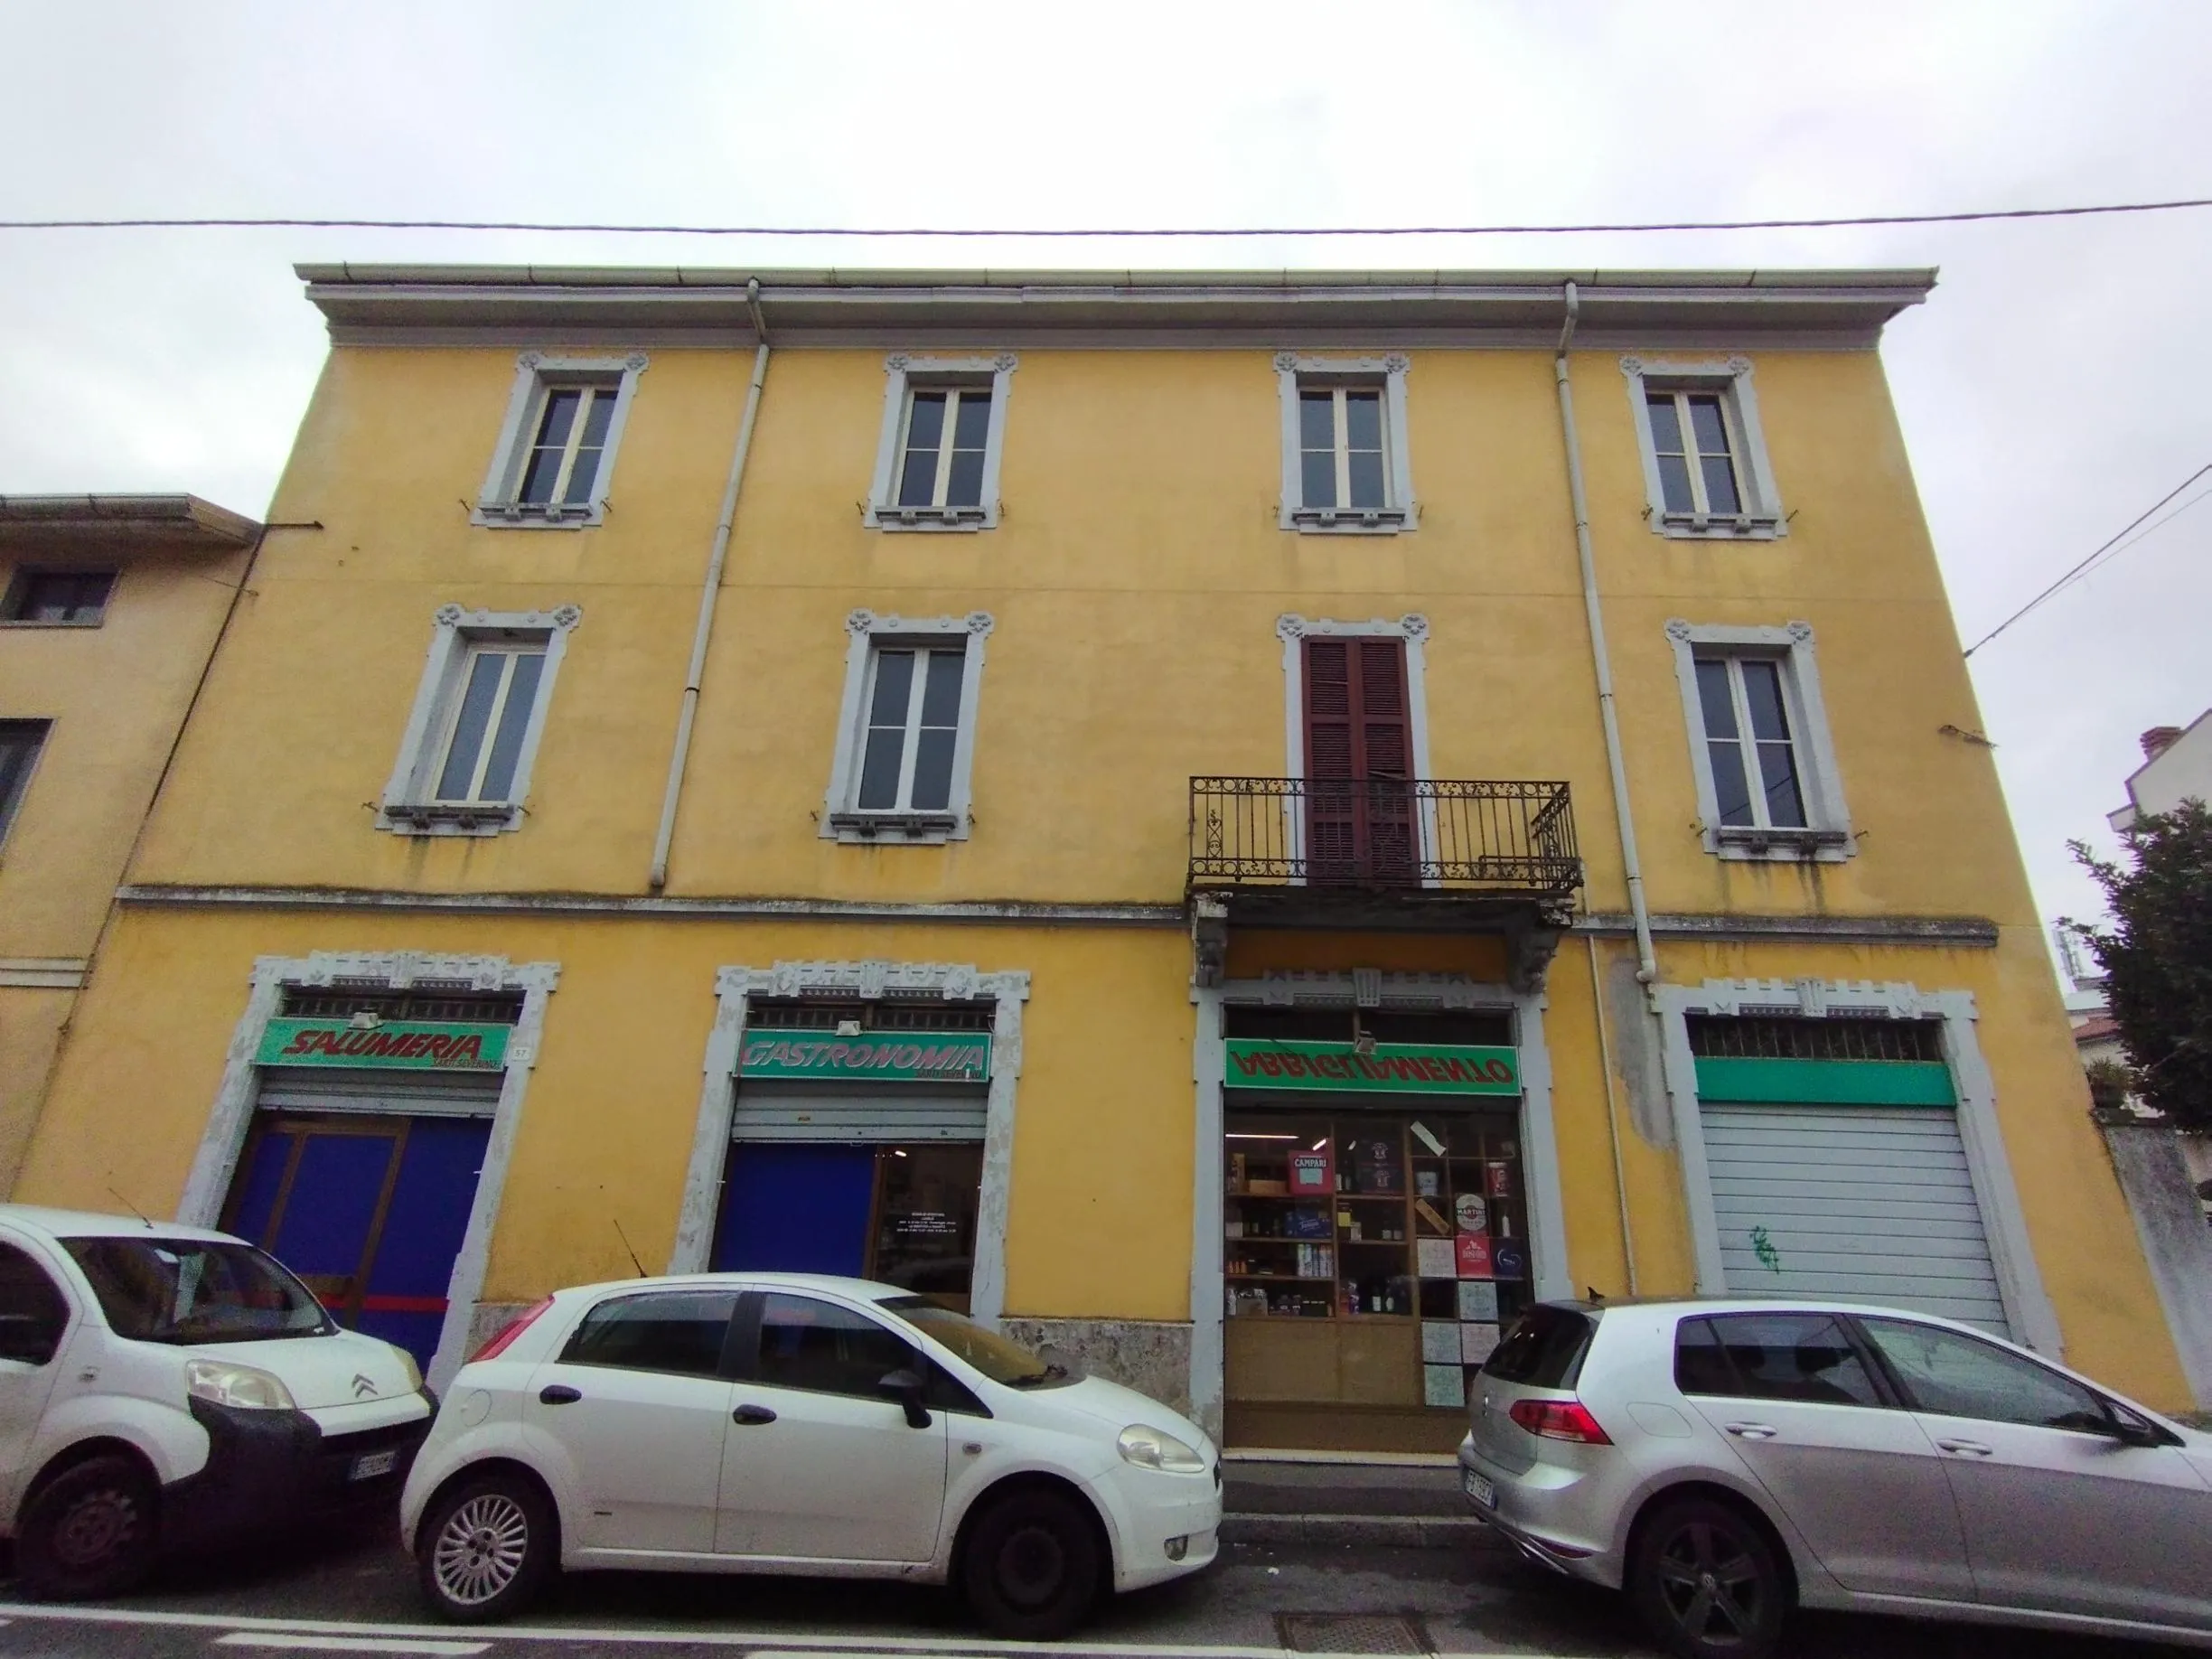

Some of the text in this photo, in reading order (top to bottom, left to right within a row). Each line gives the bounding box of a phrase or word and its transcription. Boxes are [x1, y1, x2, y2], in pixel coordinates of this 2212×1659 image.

[282, 1029, 483, 1059] SALUMERIA
[516, 1049, 528, 1057] 57
[741, 1040, 985, 1071] GASTRONOMIA
[1294, 1158, 1327, 1168] CAMPARI
[1457, 1208, 1486, 1216] MARTINI
